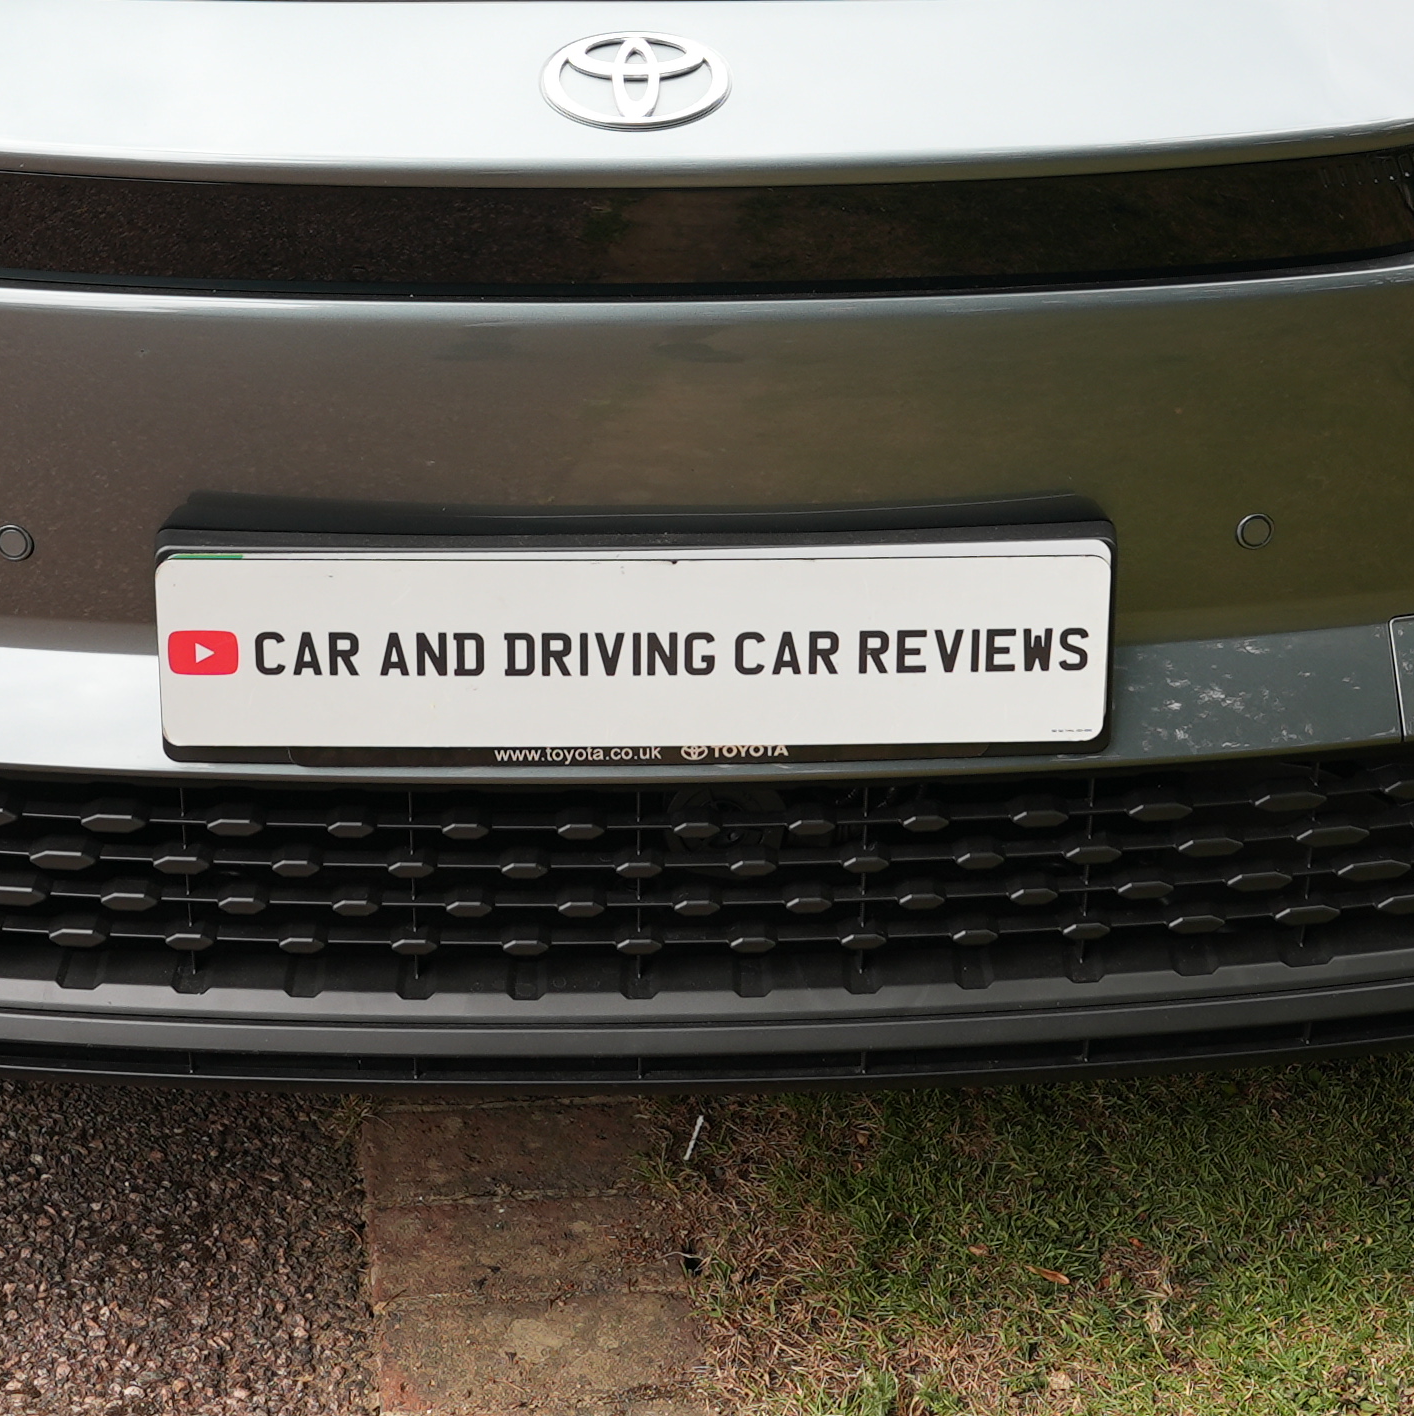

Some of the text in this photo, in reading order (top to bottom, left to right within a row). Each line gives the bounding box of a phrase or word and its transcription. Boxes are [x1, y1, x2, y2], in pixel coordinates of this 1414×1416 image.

[254, 627, 1089, 677] CAR AND DRIVING CAR REVIEWS
[494, 745, 789, 765] www.toyota.co.uk TOYOTA
